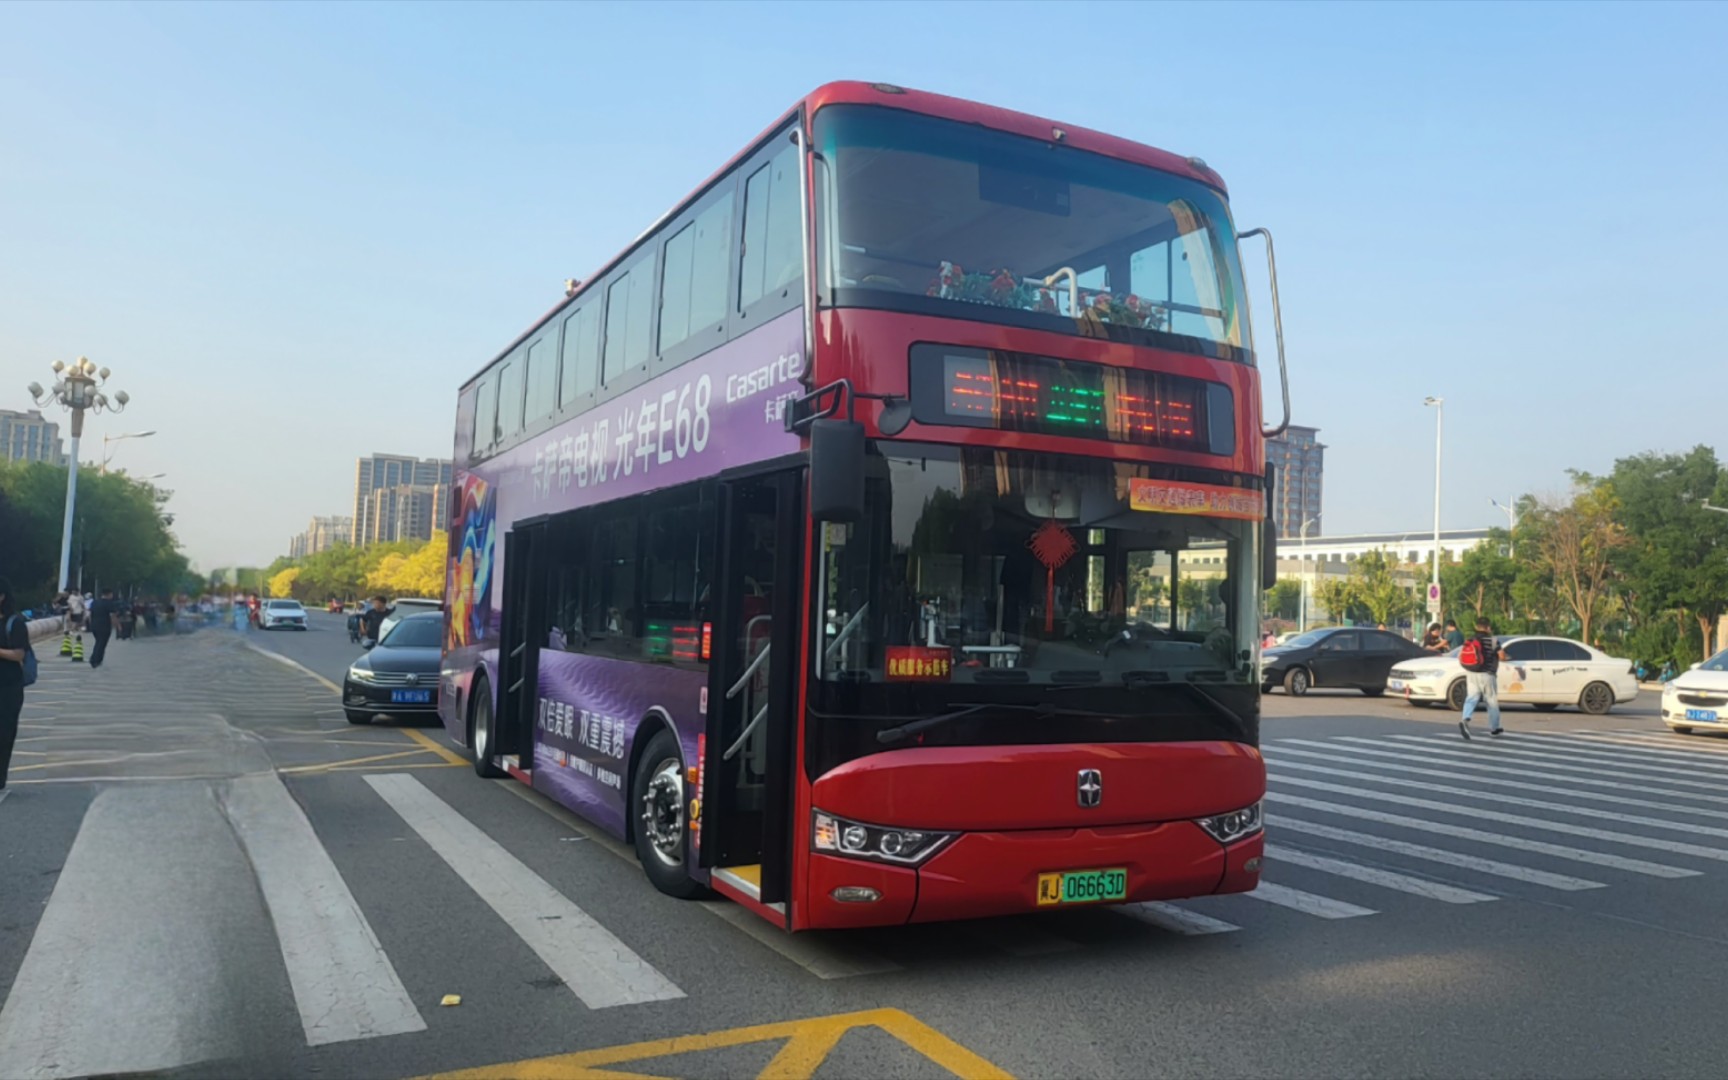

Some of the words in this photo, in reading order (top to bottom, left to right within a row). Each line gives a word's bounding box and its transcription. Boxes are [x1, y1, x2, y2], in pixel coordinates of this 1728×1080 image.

[726, 352, 803, 403] Casarte
[531, 419, 609, 503] 卡萨帝电视
[613, 374, 711, 480] 光年E68
